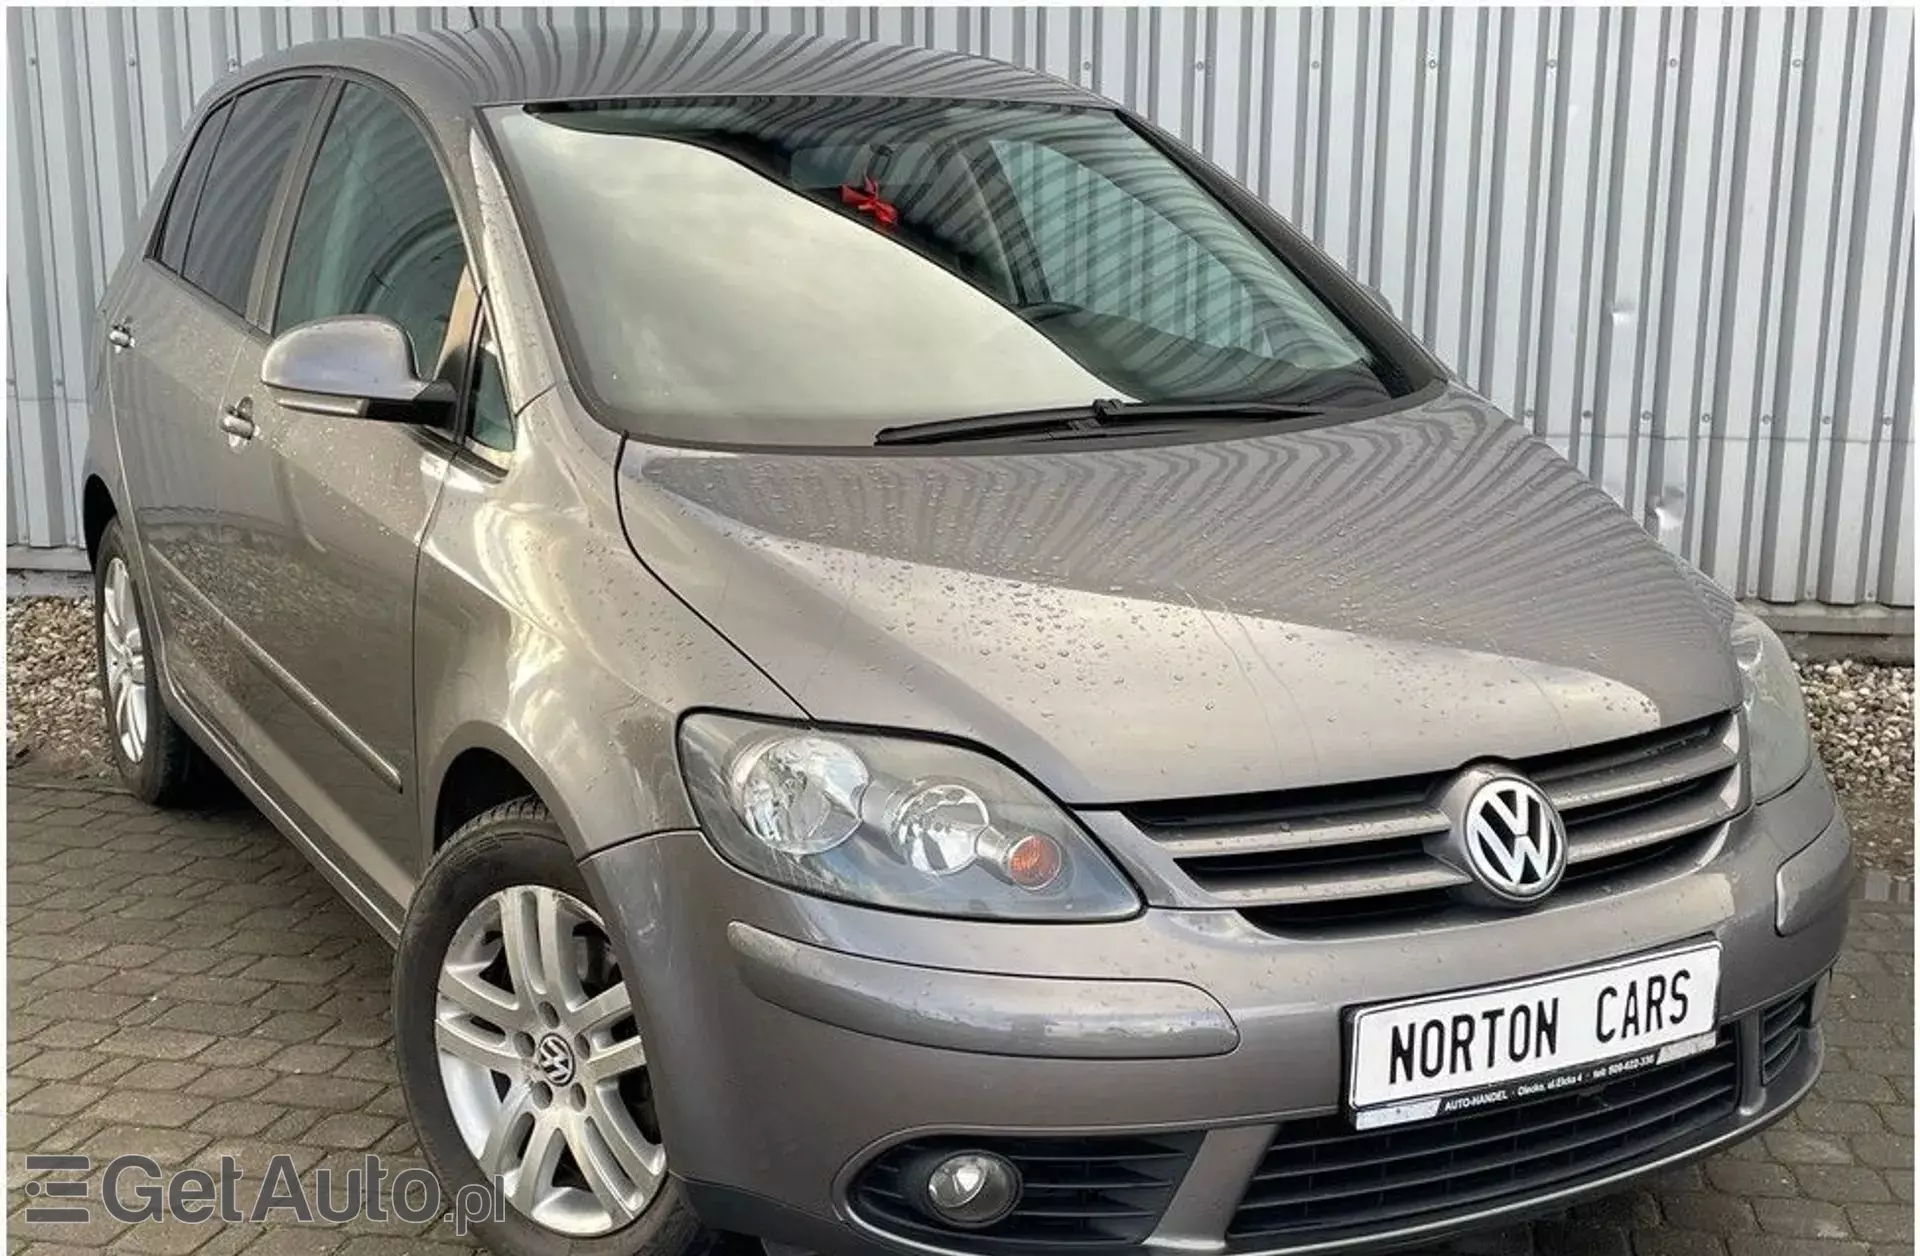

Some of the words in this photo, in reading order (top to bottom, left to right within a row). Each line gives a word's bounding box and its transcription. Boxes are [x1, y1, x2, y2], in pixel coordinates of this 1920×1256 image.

[1467, 778, 1563, 897] VW
[1389, 997, 1559, 1085] NORTON
[1596, 969, 1691, 1043] CARS
[1445, 1090, 1508, 1112] AUTO-HANDEL
